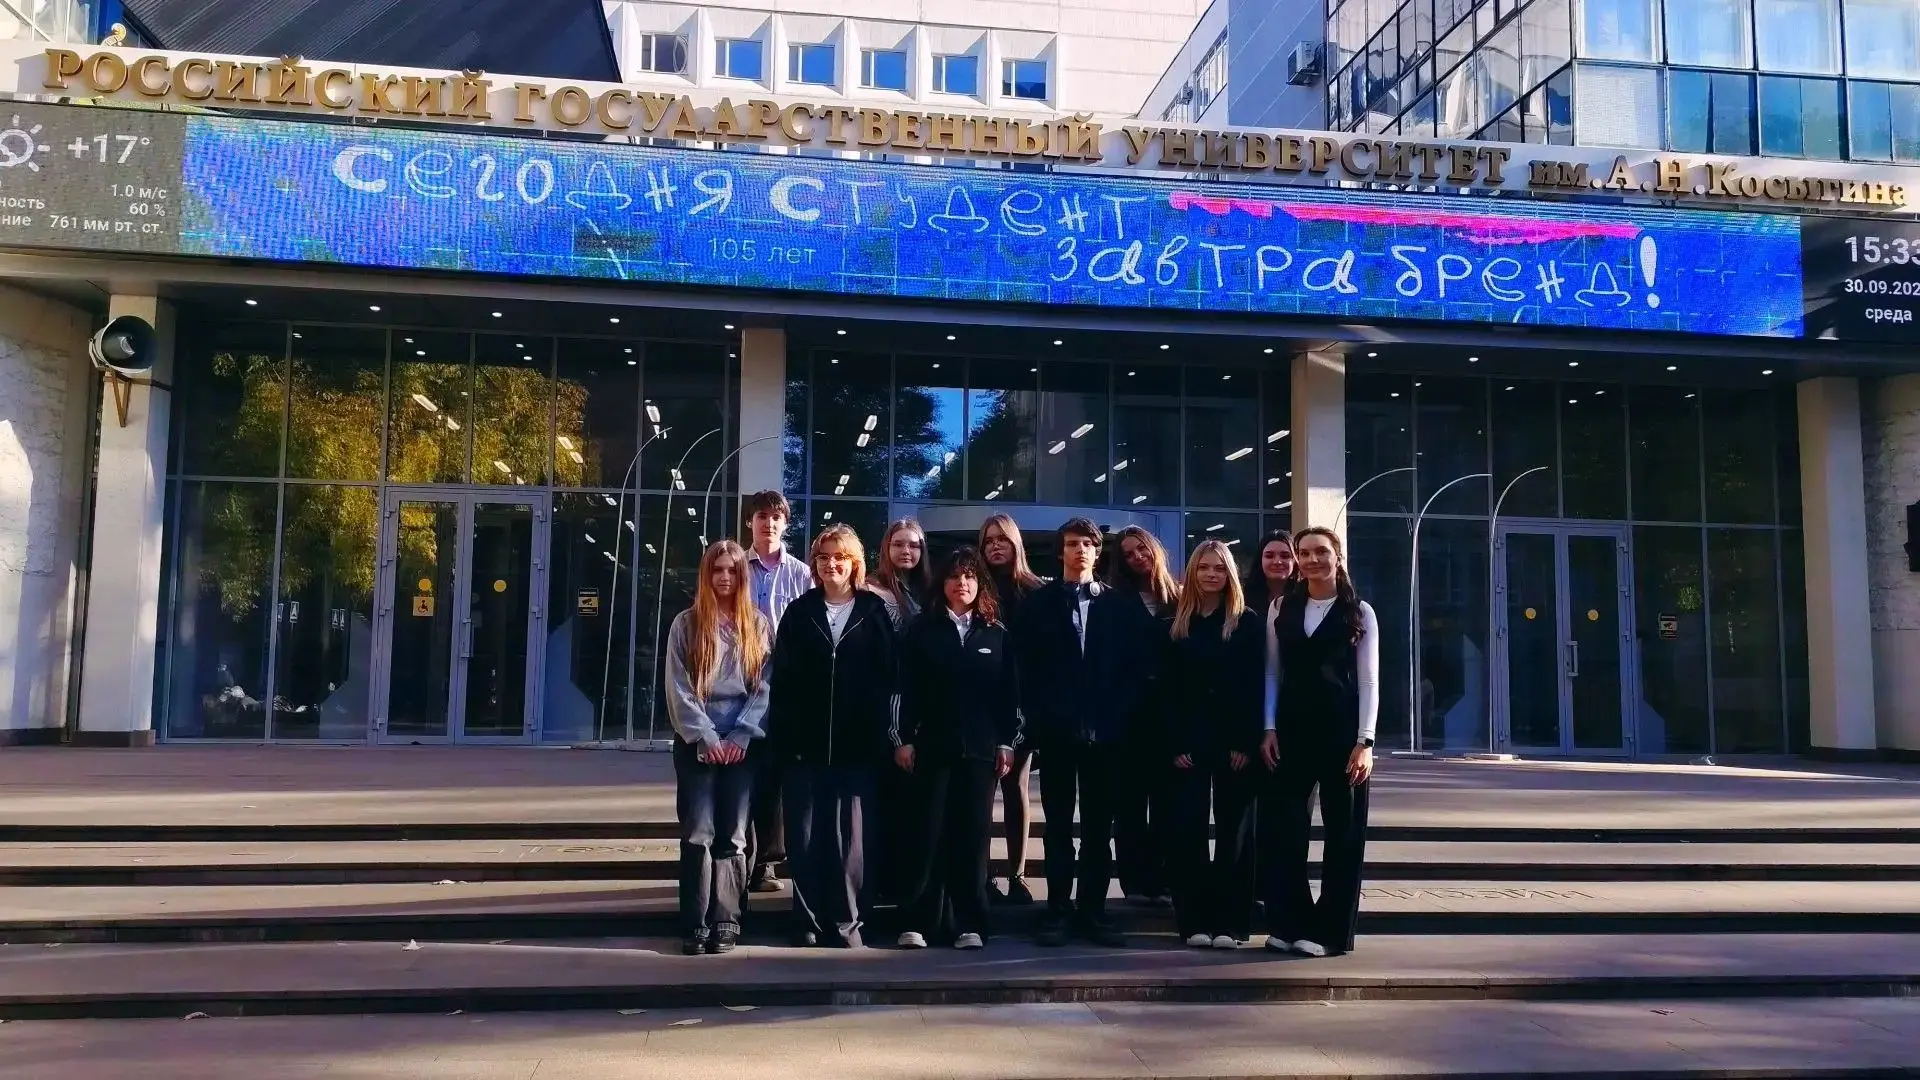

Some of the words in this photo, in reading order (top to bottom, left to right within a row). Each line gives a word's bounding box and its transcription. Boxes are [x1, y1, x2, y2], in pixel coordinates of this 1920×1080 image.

[43, 47, 492, 118] РОССИЙСКИЙ
[513, 82, 1103, 160] ГОСУДАРСТВЕННЫЙ
[1122, 125, 1511, 184] УНИВЕРСИТЕТ
[111, 184, 134, 198] 1.0
[139, 186, 167, 200] м/с
[129, 202, 148, 216] 60
[154, 204, 166, 217] %
[50, 215, 77, 228] 761
[84, 218, 109, 232] мм
[708, 237, 757, 262] 105
[766, 245, 817, 265] лет
[1865, 307, 1913, 324] среда
